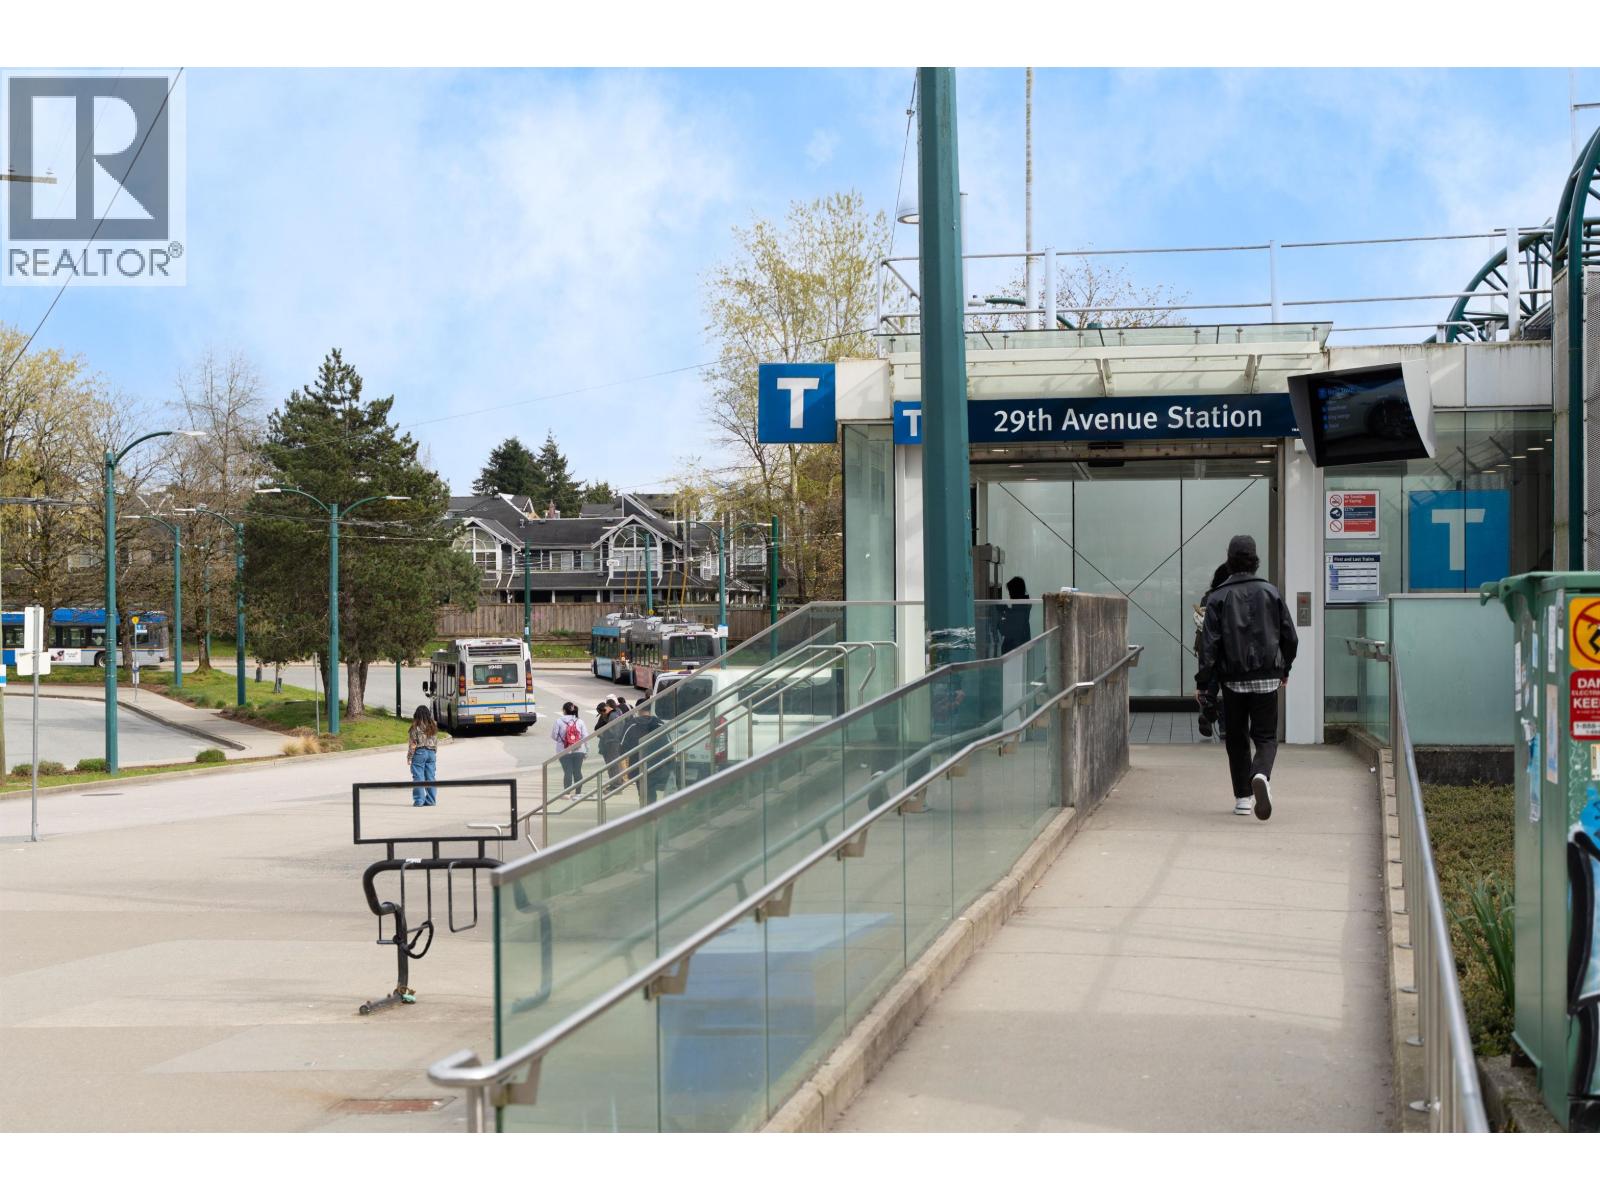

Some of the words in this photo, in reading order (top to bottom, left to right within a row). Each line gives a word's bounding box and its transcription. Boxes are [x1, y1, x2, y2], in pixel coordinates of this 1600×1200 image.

[777, 377, 819, 429] T
[902, 409, 922, 437] T
[994, 408, 1052, 433] 29th
[1062, 408, 1158, 431] Avenue
[1168, 404, 1262, 429] Station
[1432, 508, 1486, 571] T
